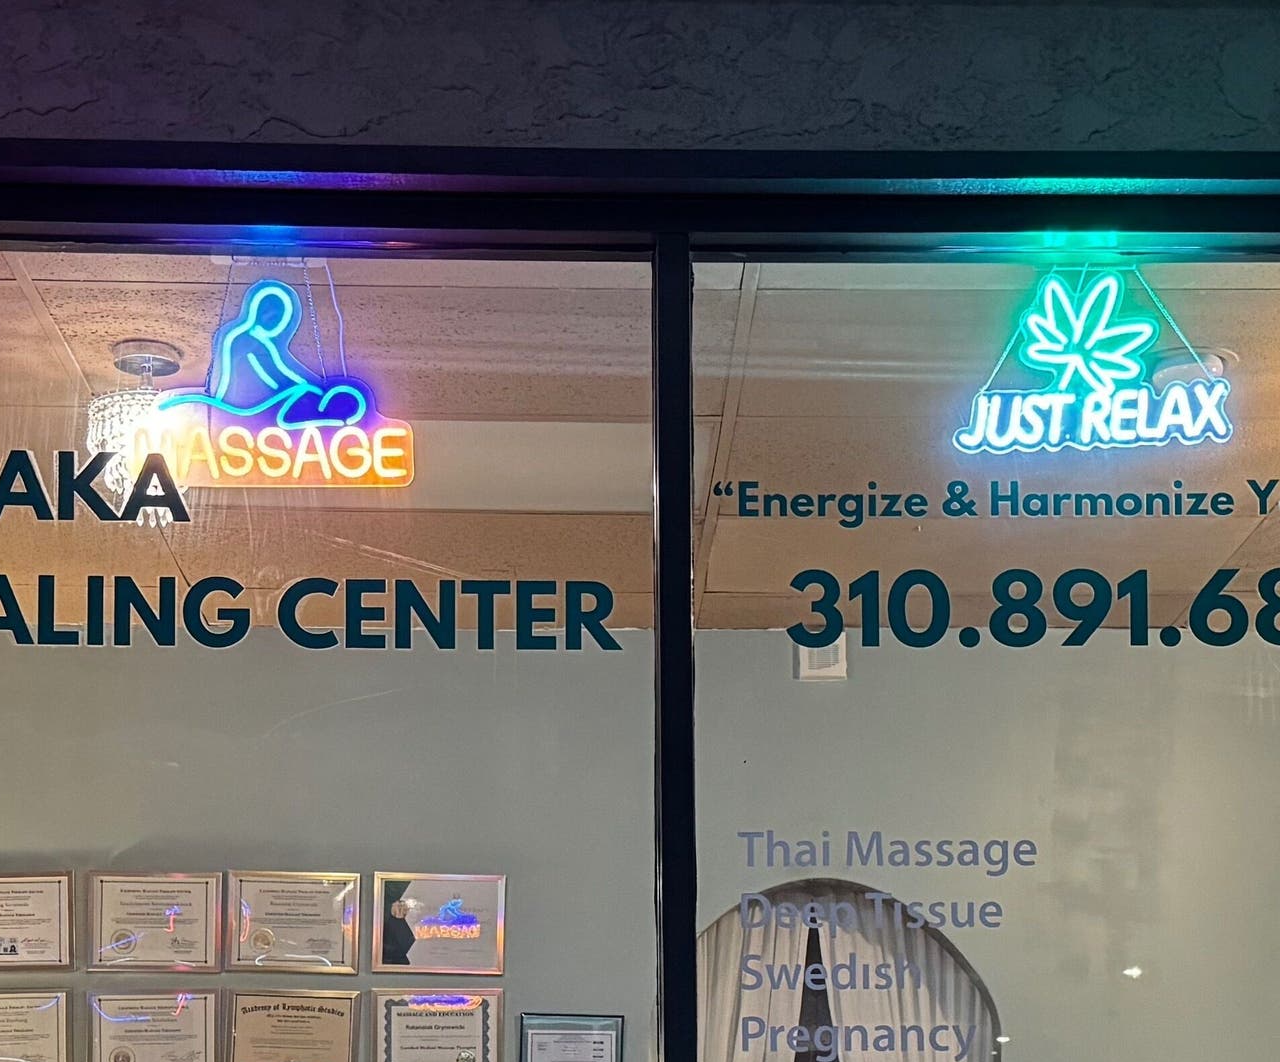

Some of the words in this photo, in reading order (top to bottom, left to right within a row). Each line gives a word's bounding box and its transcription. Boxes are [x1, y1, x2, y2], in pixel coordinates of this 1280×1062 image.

[968, 394, 1070, 448] JUST
[1081, 384, 1231, 443] RELAX
[942, 482, 977, 517] &
[990, 479, 1235, 517] Harmonize
[277, 578, 624, 652] CENTER
[737, 830, 830, 867] Thai
[845, 831, 1038, 877] Massage
[739, 893, 857, 937] Deep
[864, 893, 1003, 929] Tissue
[740, 953, 926, 991] Swedish
[740, 1016, 977, 1062] Pregnancy
